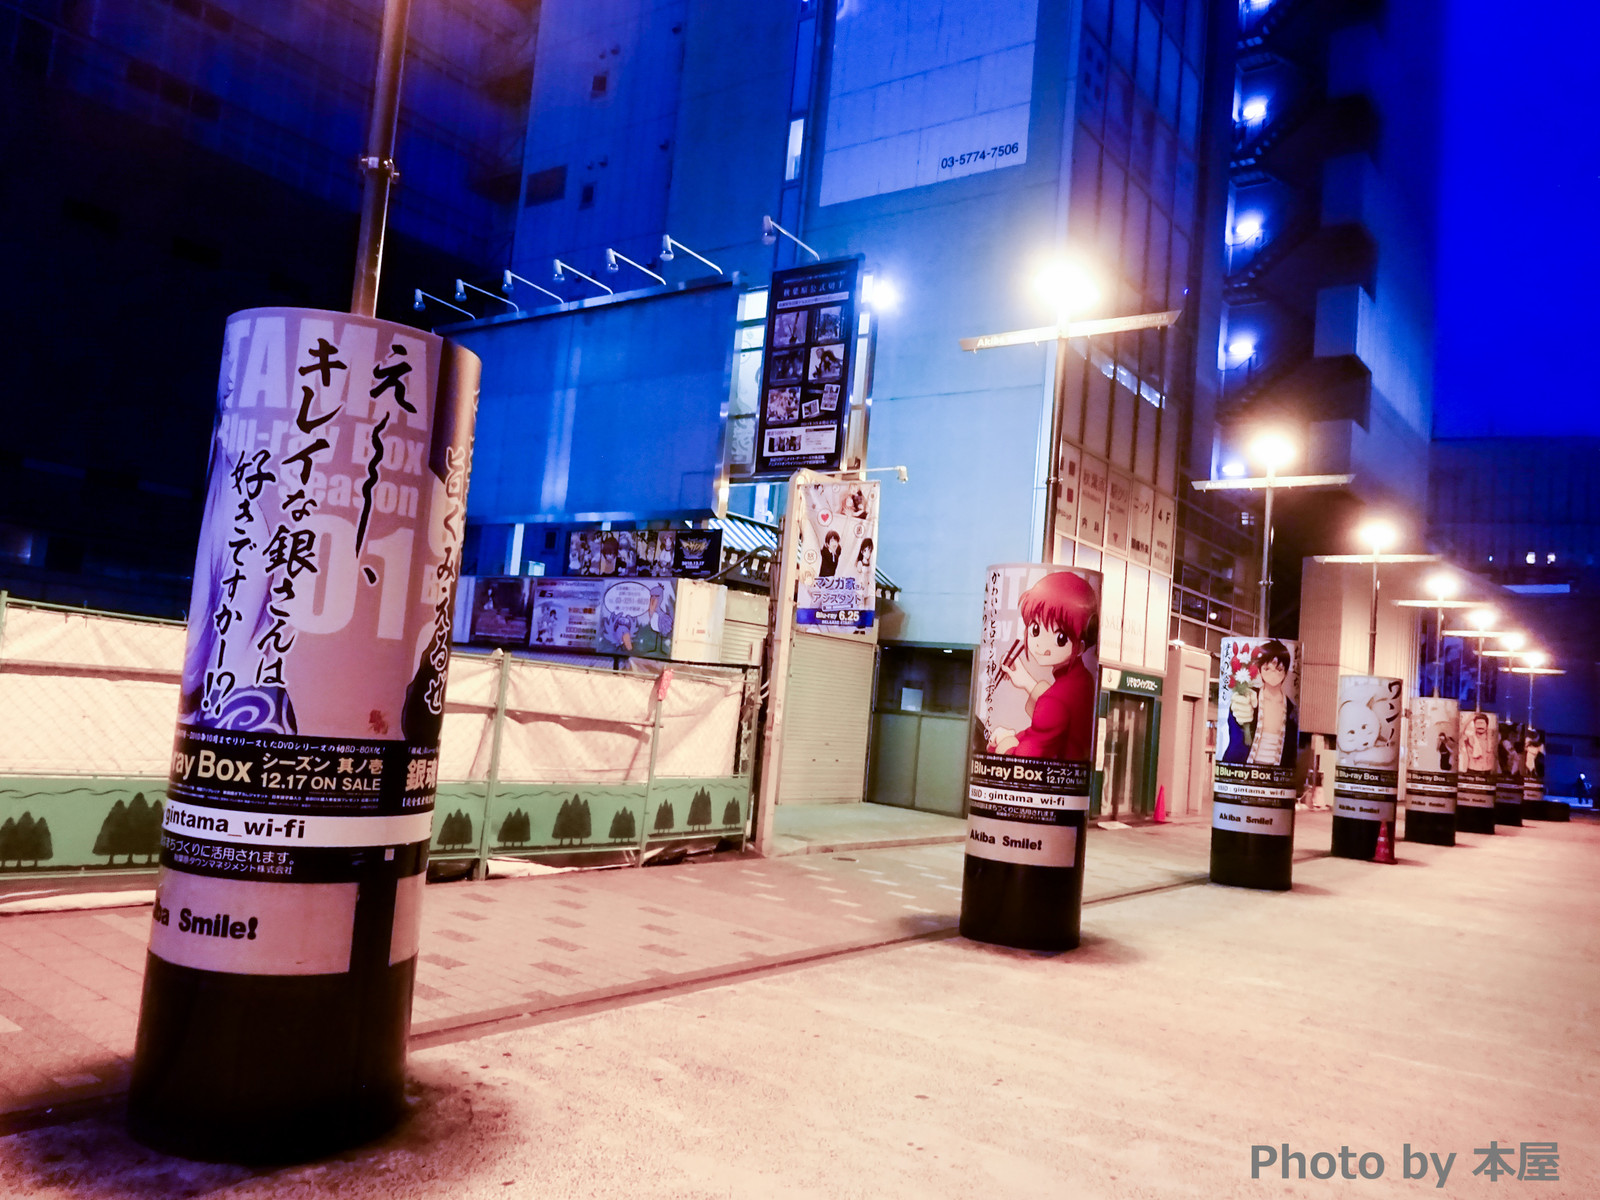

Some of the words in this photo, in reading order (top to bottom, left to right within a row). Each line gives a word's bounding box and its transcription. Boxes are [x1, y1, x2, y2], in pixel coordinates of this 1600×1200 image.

[941, 142, 1019, 169] 03-5774-7506
[256, 338, 347, 687] キレイな銀さんは
[838, 610, 860, 622] 6.25
[198, 750, 253, 783] Box
[263, 753, 331, 772] シーズン
[973, 761, 1011, 780] Blu-ray
[1013, 765, 1043, 781] Box
[1046, 766, 1073, 776] シーズン
[261, 772, 308, 790] 12.17
[311, 776, 337, 790] ON
[342, 777, 382, 791] SALE
[1046, 776, 1064, 784] 12.17
[1220, 766, 1249, 780] Blu-ray
[1251, 769, 1272, 780] Box
[1364, 772, 1379, 781] Box
[1219, 812, 1241, 822] Akiba
[970, 829, 996, 844] Akiba
[1002, 836, 1042, 851] Smile!
[179, 908, 258, 940] Smile!
